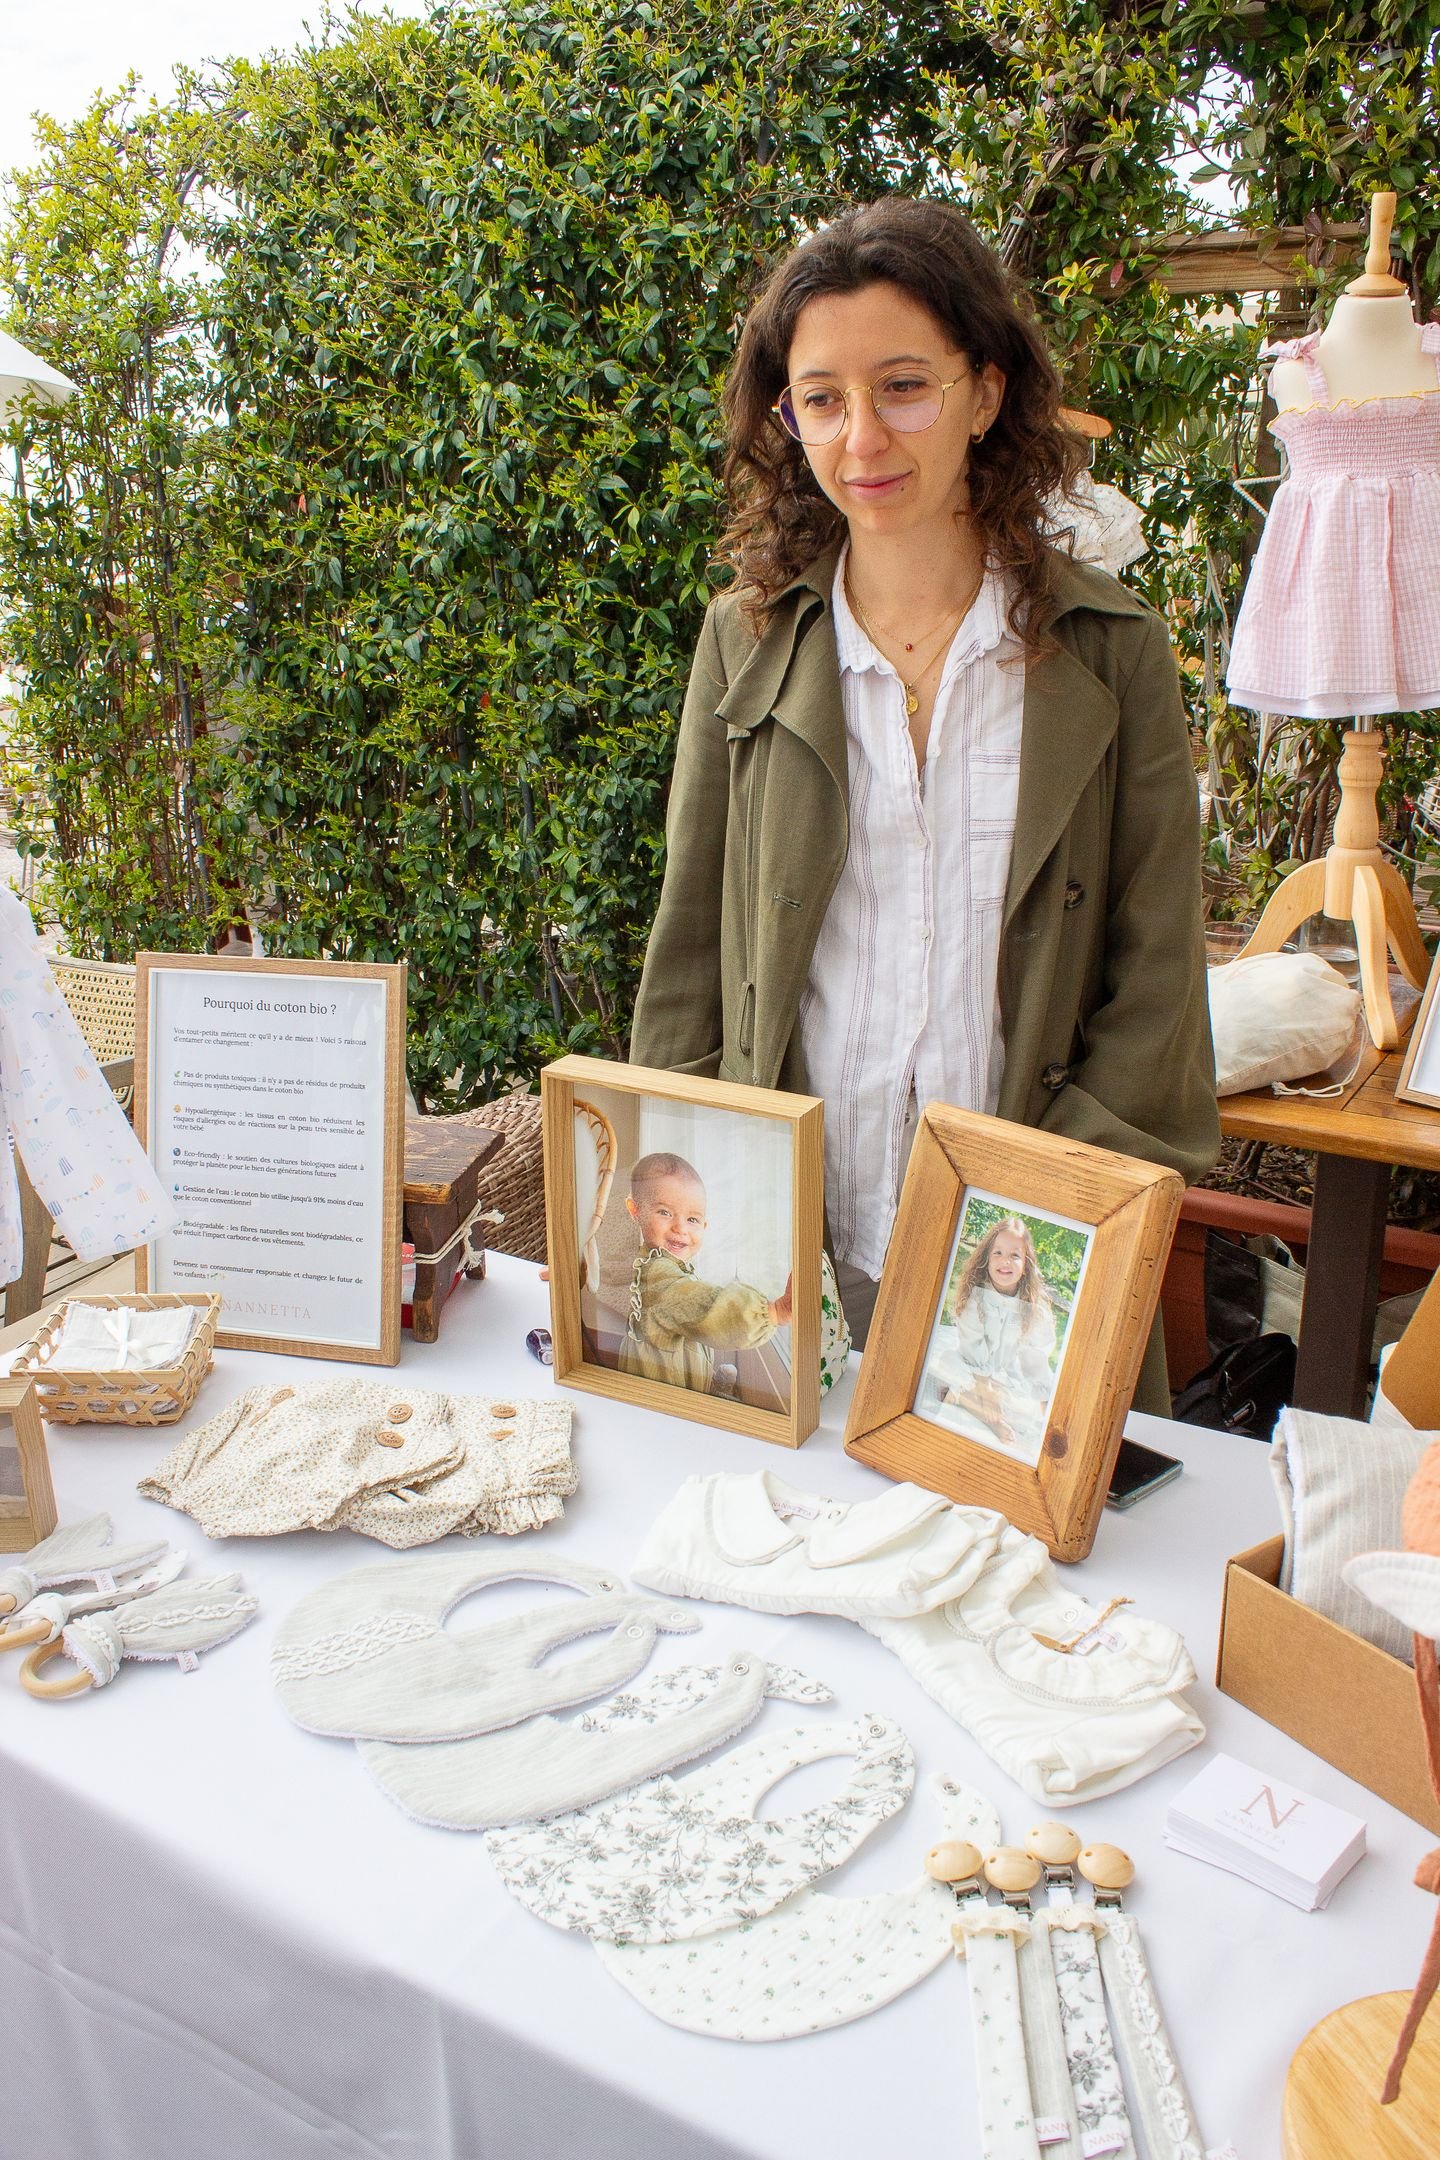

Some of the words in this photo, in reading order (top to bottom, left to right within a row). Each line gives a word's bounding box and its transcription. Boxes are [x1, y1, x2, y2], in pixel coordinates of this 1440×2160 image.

[204, 997, 253, 1012] Pourquoi
[256, 999, 270, 1012] du
[274, 1001, 306, 1014] coton
[310, 1002, 327, 1015] bio
[331, 1003, 337, 1015] ?
[223, 1299, 312, 1319] NANNETTA
[1240, 1784, 1304, 1829] N
